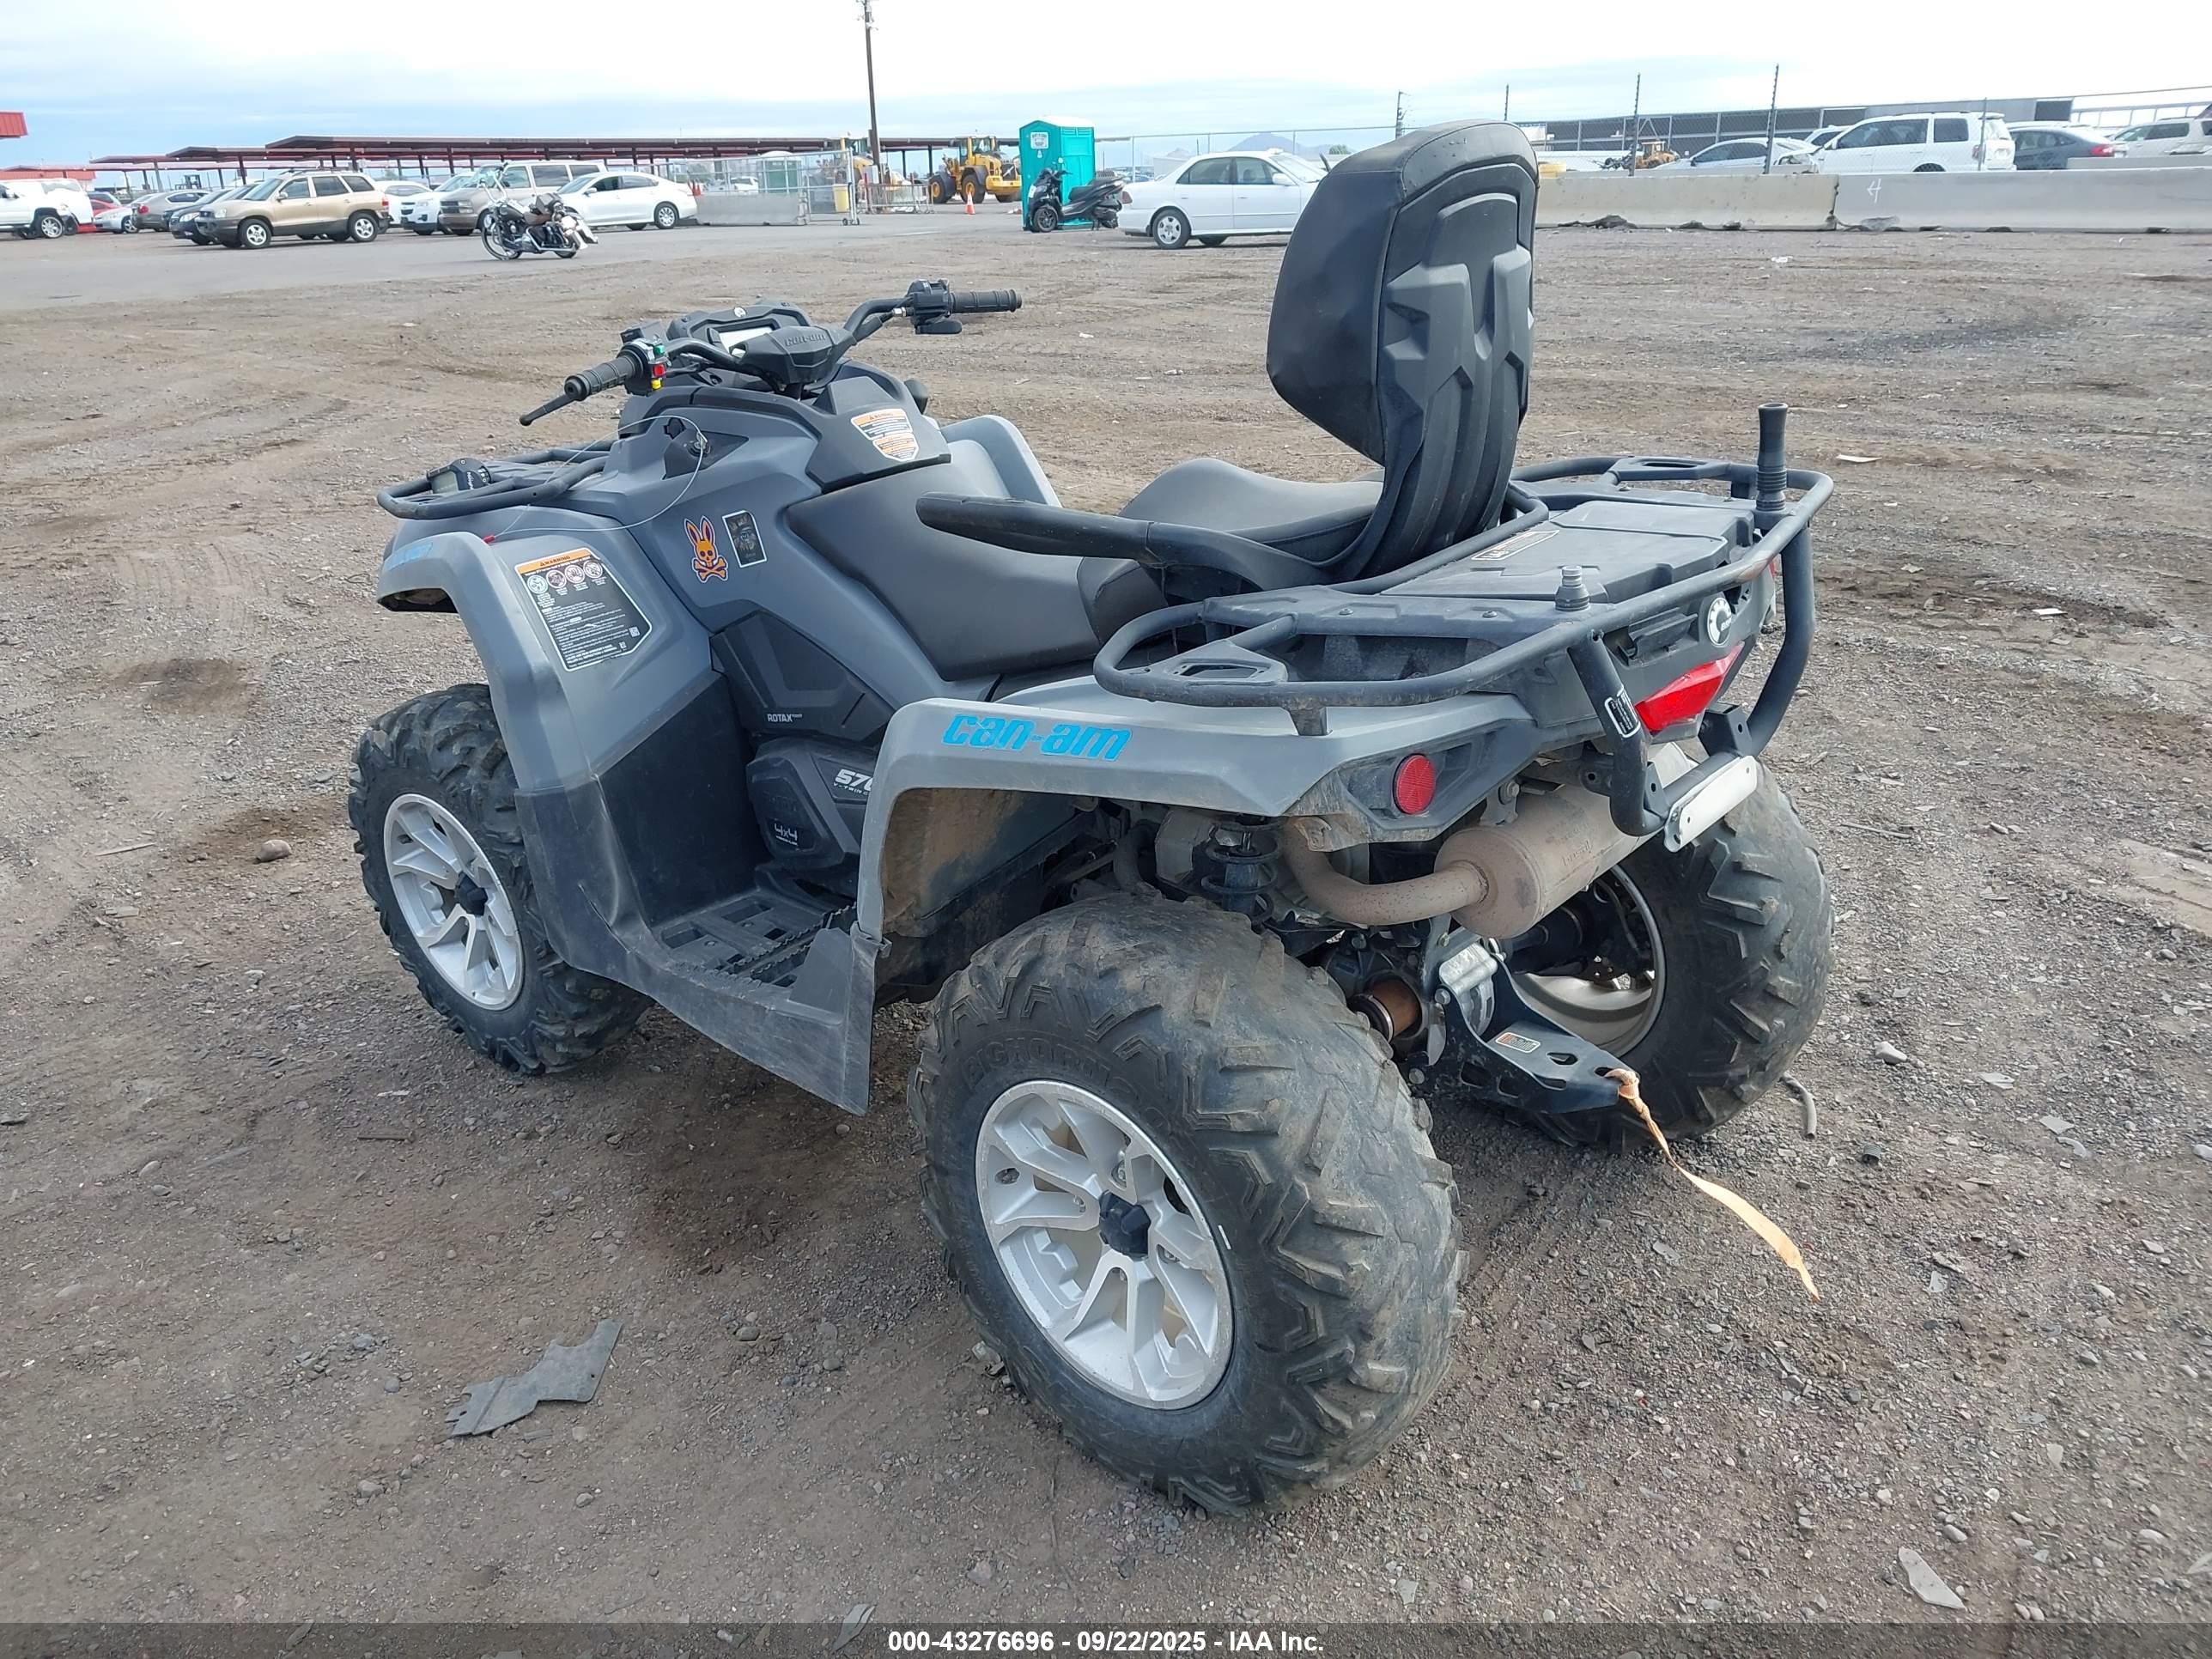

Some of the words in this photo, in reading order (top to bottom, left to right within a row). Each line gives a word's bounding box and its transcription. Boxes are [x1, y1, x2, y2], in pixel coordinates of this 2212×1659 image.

[784, 334, 826, 346] can-am
[767, 714, 793, 722] ROTAX
[942, 714, 1133, 762] can-am
[774, 823, 798, 842] 4x4
